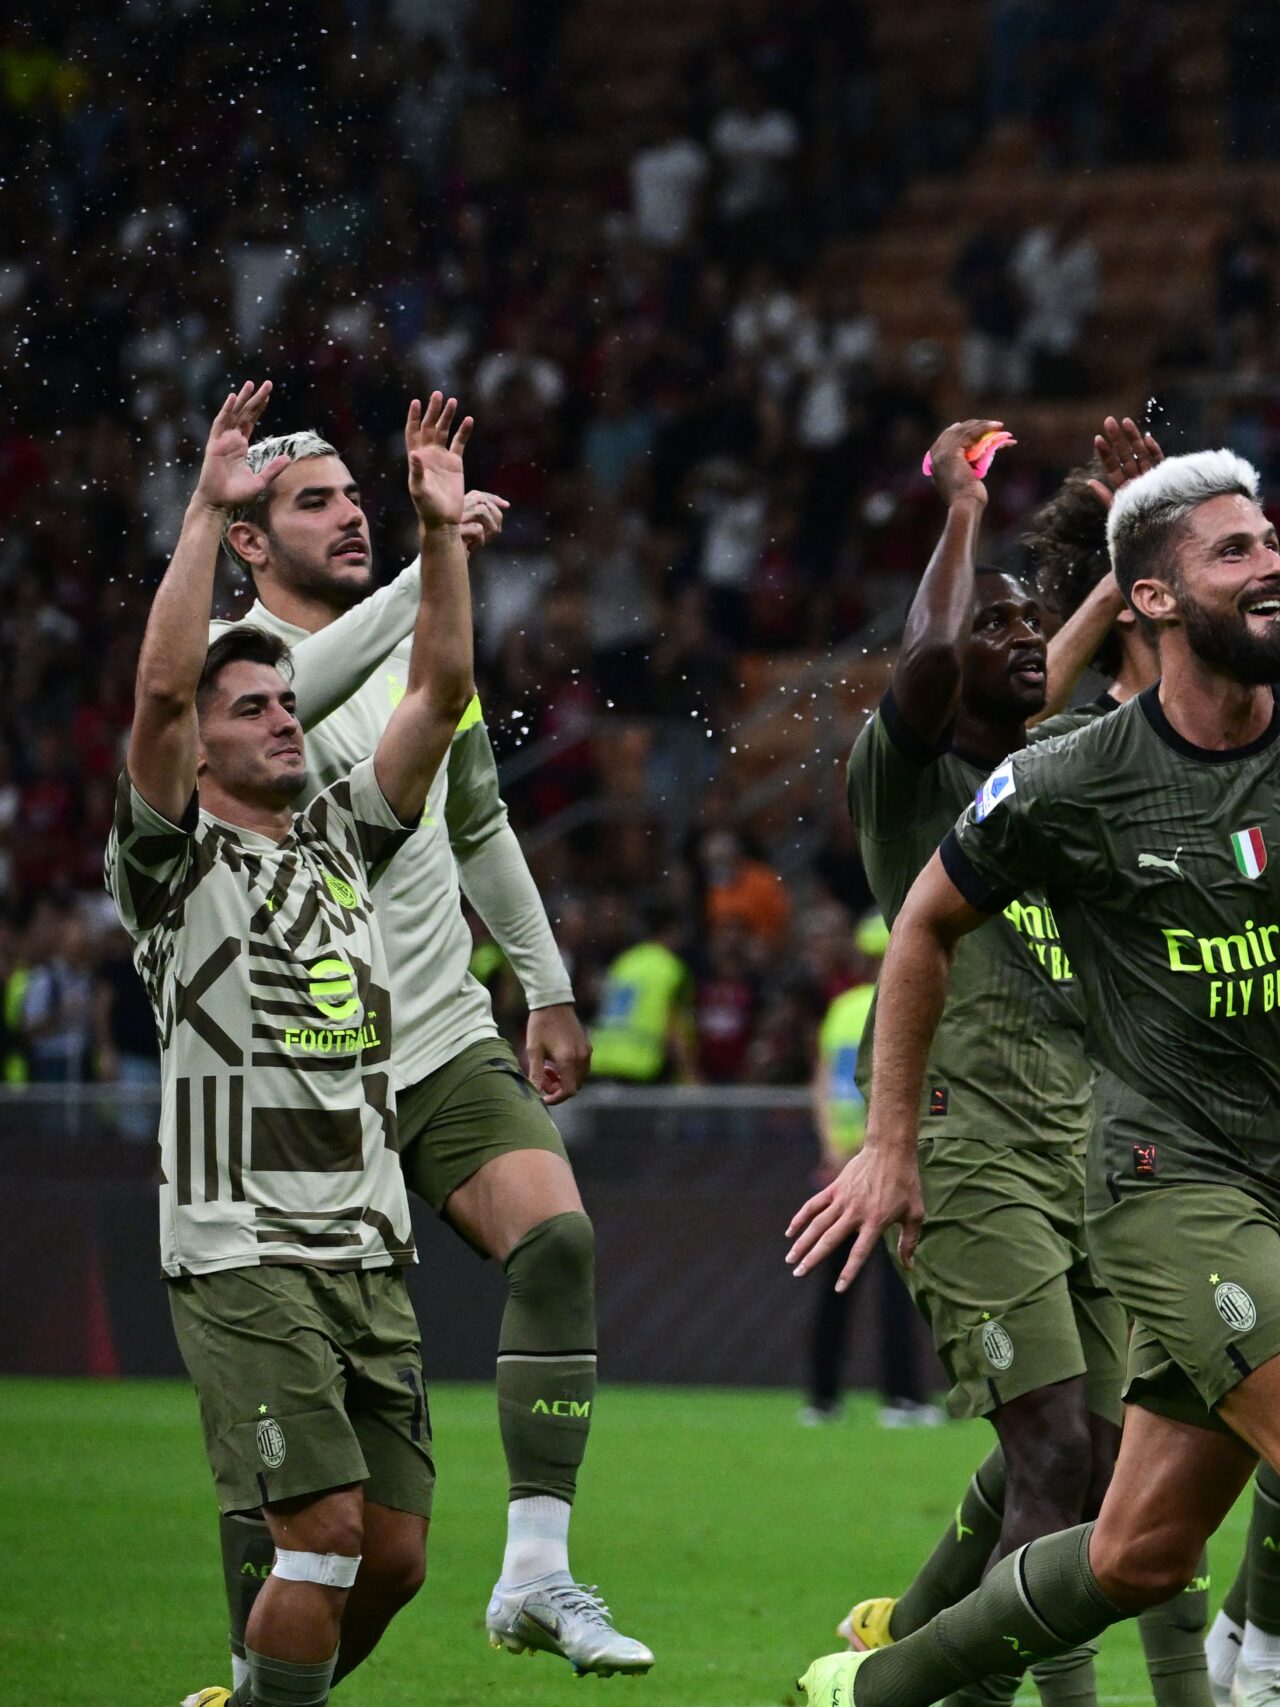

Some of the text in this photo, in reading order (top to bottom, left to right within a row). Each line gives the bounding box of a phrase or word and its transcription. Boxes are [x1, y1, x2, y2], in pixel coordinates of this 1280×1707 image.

[1209, 978, 1253, 1018] FLY
[284, 1024, 381, 1054] FOOTBALL
[532, 1399, 590, 1418] ACM
[240, 1561, 273, 1579] AC
